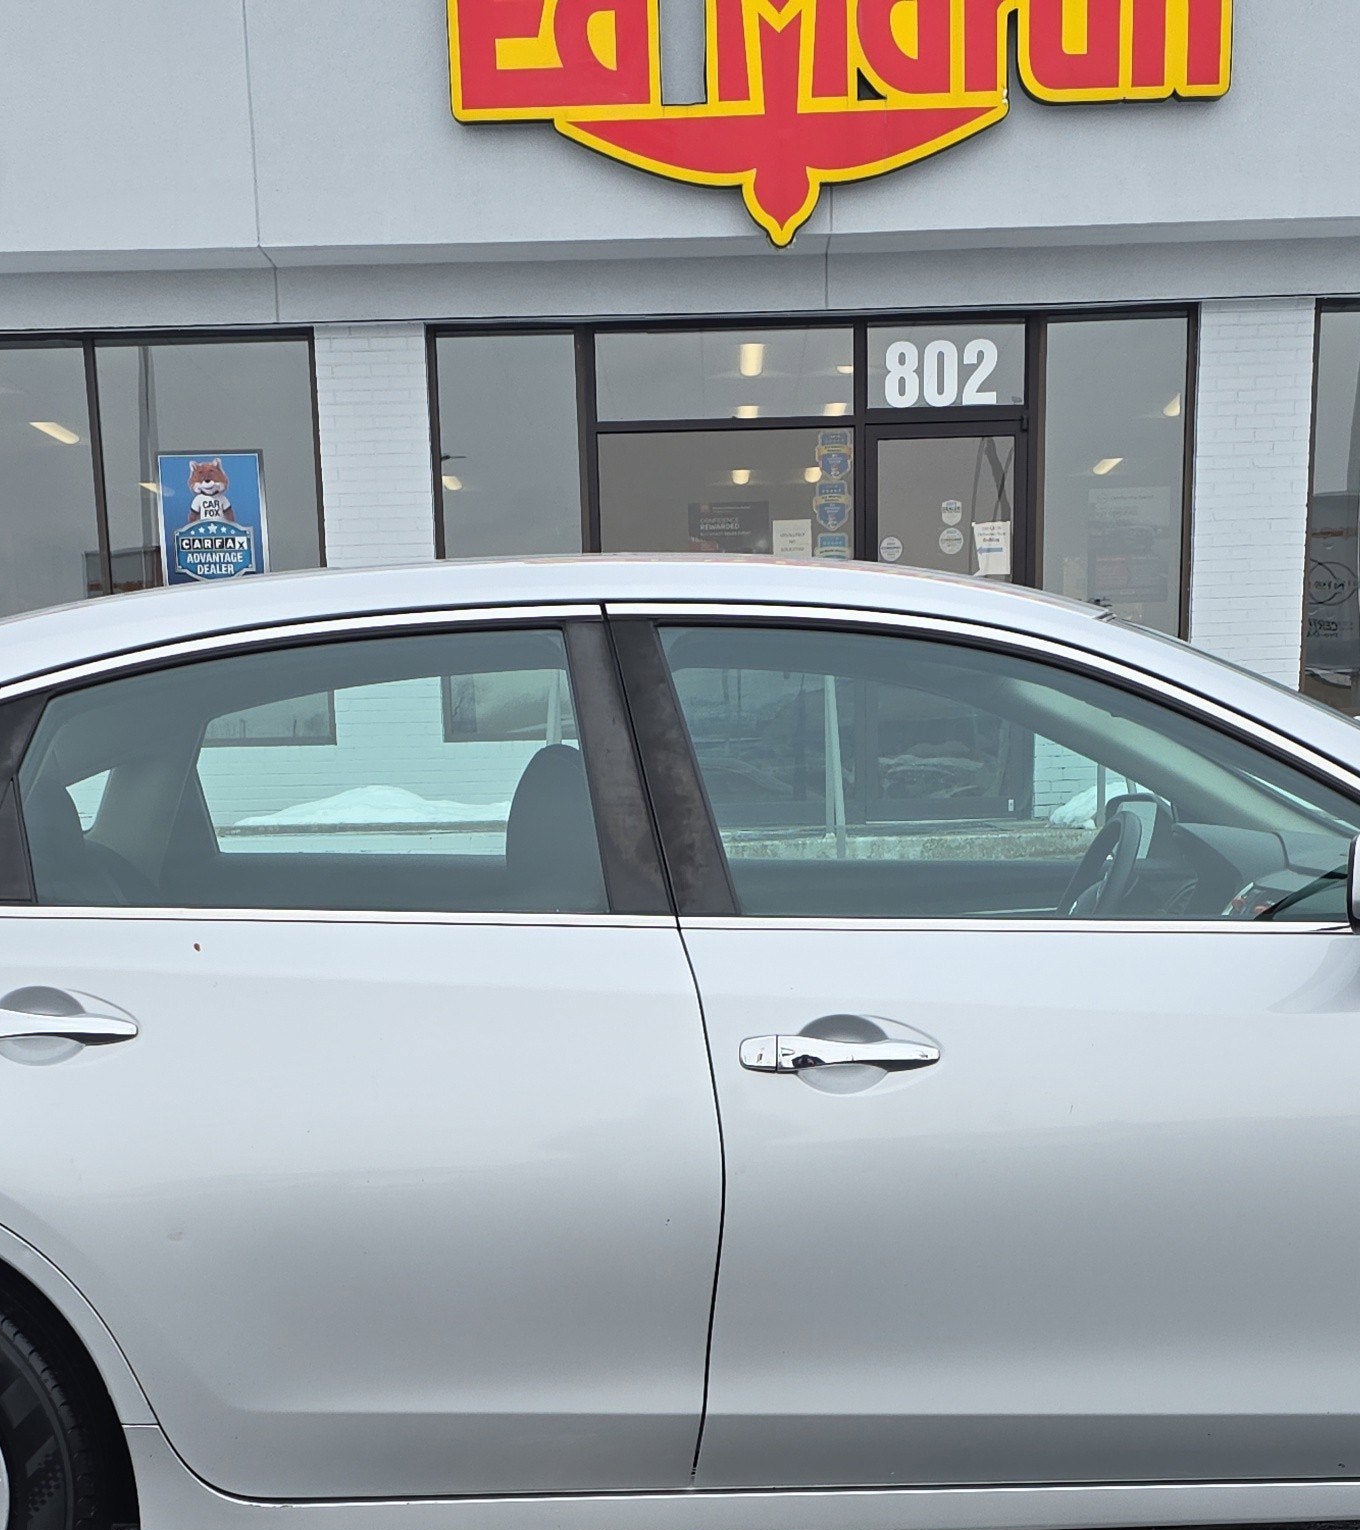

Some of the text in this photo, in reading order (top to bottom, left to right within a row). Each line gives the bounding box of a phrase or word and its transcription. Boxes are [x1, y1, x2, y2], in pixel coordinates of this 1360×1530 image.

[884, 338, 999, 408] 802
[202, 500, 220, 509] CAR
[204, 509, 220, 517] FOX
[181, 537, 247, 550] CARFAX
[187, 551, 243, 563] ADVANTAGE
[197, 563, 235, 575] DEALER
